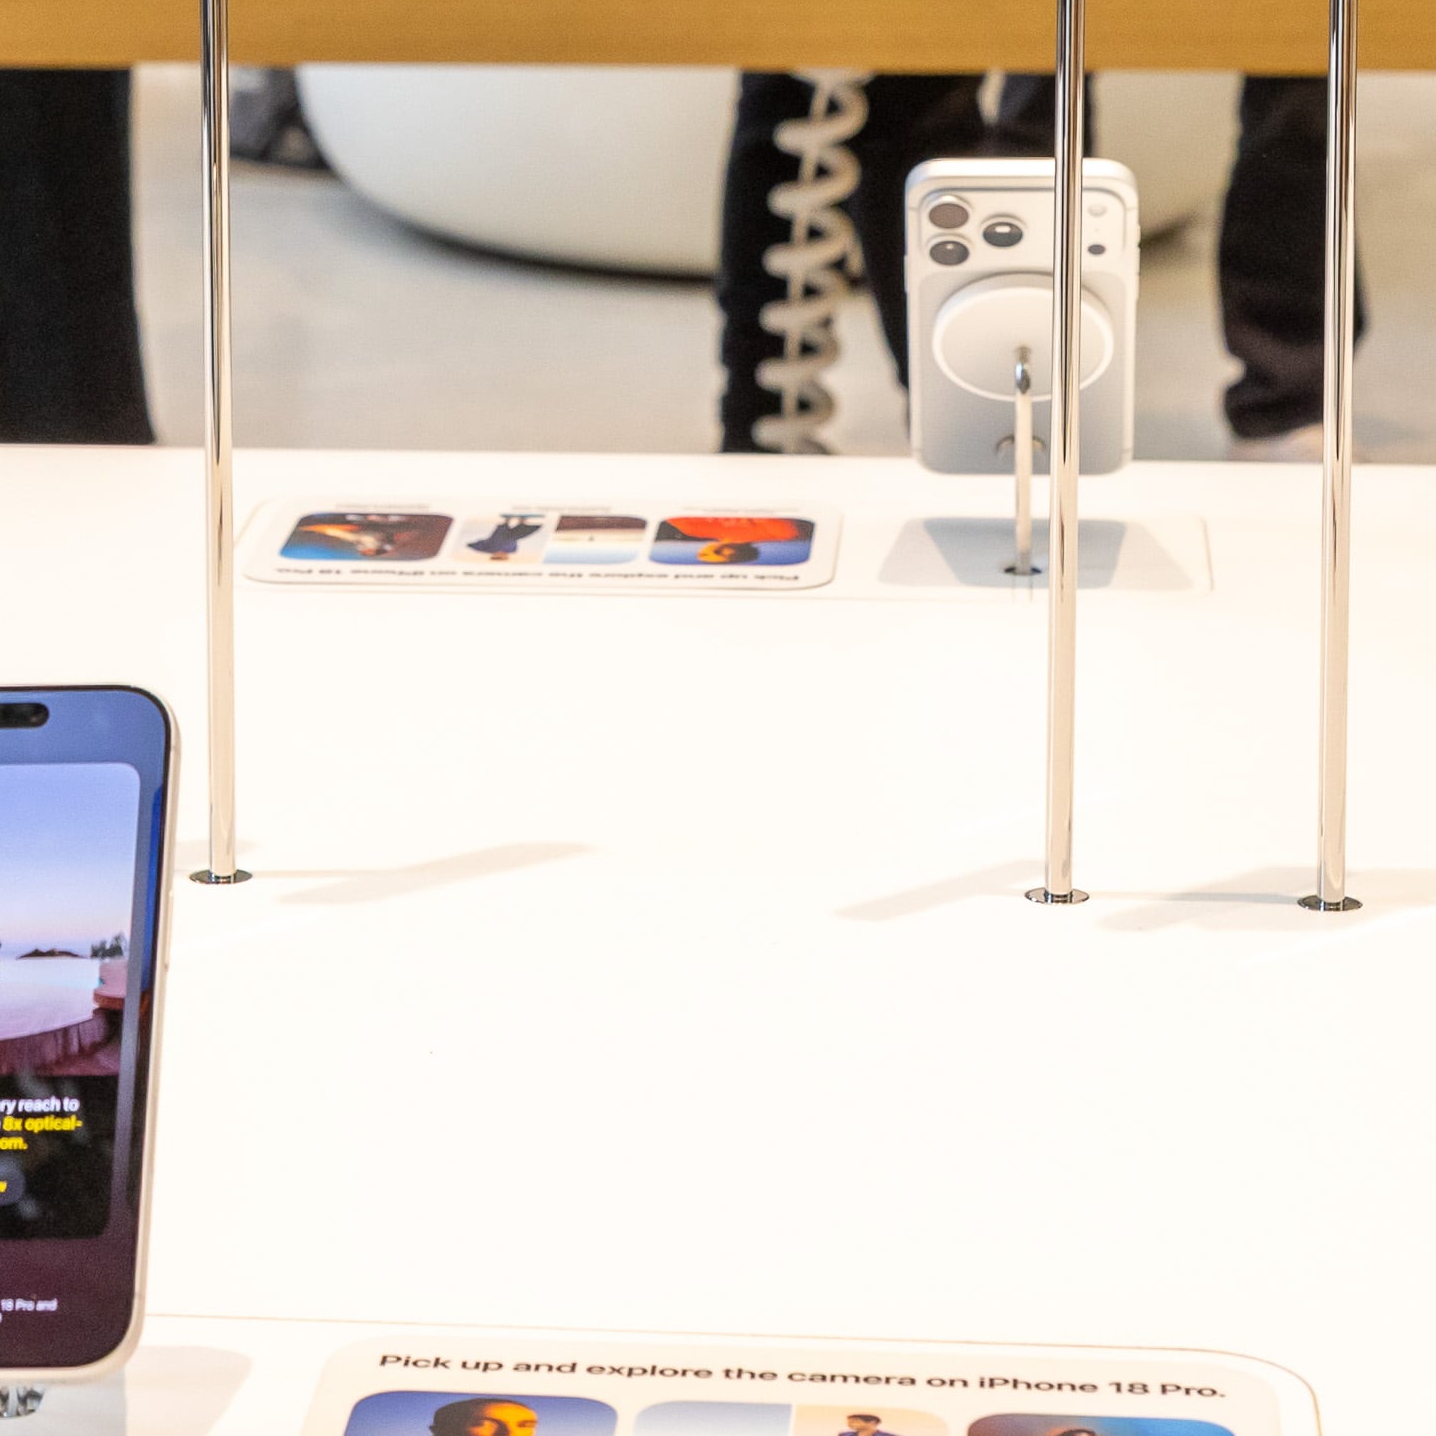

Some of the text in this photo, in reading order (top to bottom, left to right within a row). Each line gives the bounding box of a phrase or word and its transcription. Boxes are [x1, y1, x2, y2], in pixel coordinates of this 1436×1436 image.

[17, 1096, 61, 1112] reach
[63, 1097, 80, 1112] to
[2, 1115, 23, 1131] 8x
[24, 1115, 83, 1133] optical-
[15, 1298, 35, 1312] Pro
[36, 1298, 58, 1312] and
[379, 1354, 1227, 1398] Pick up and explore the camera on iPhone 18 Pro.
